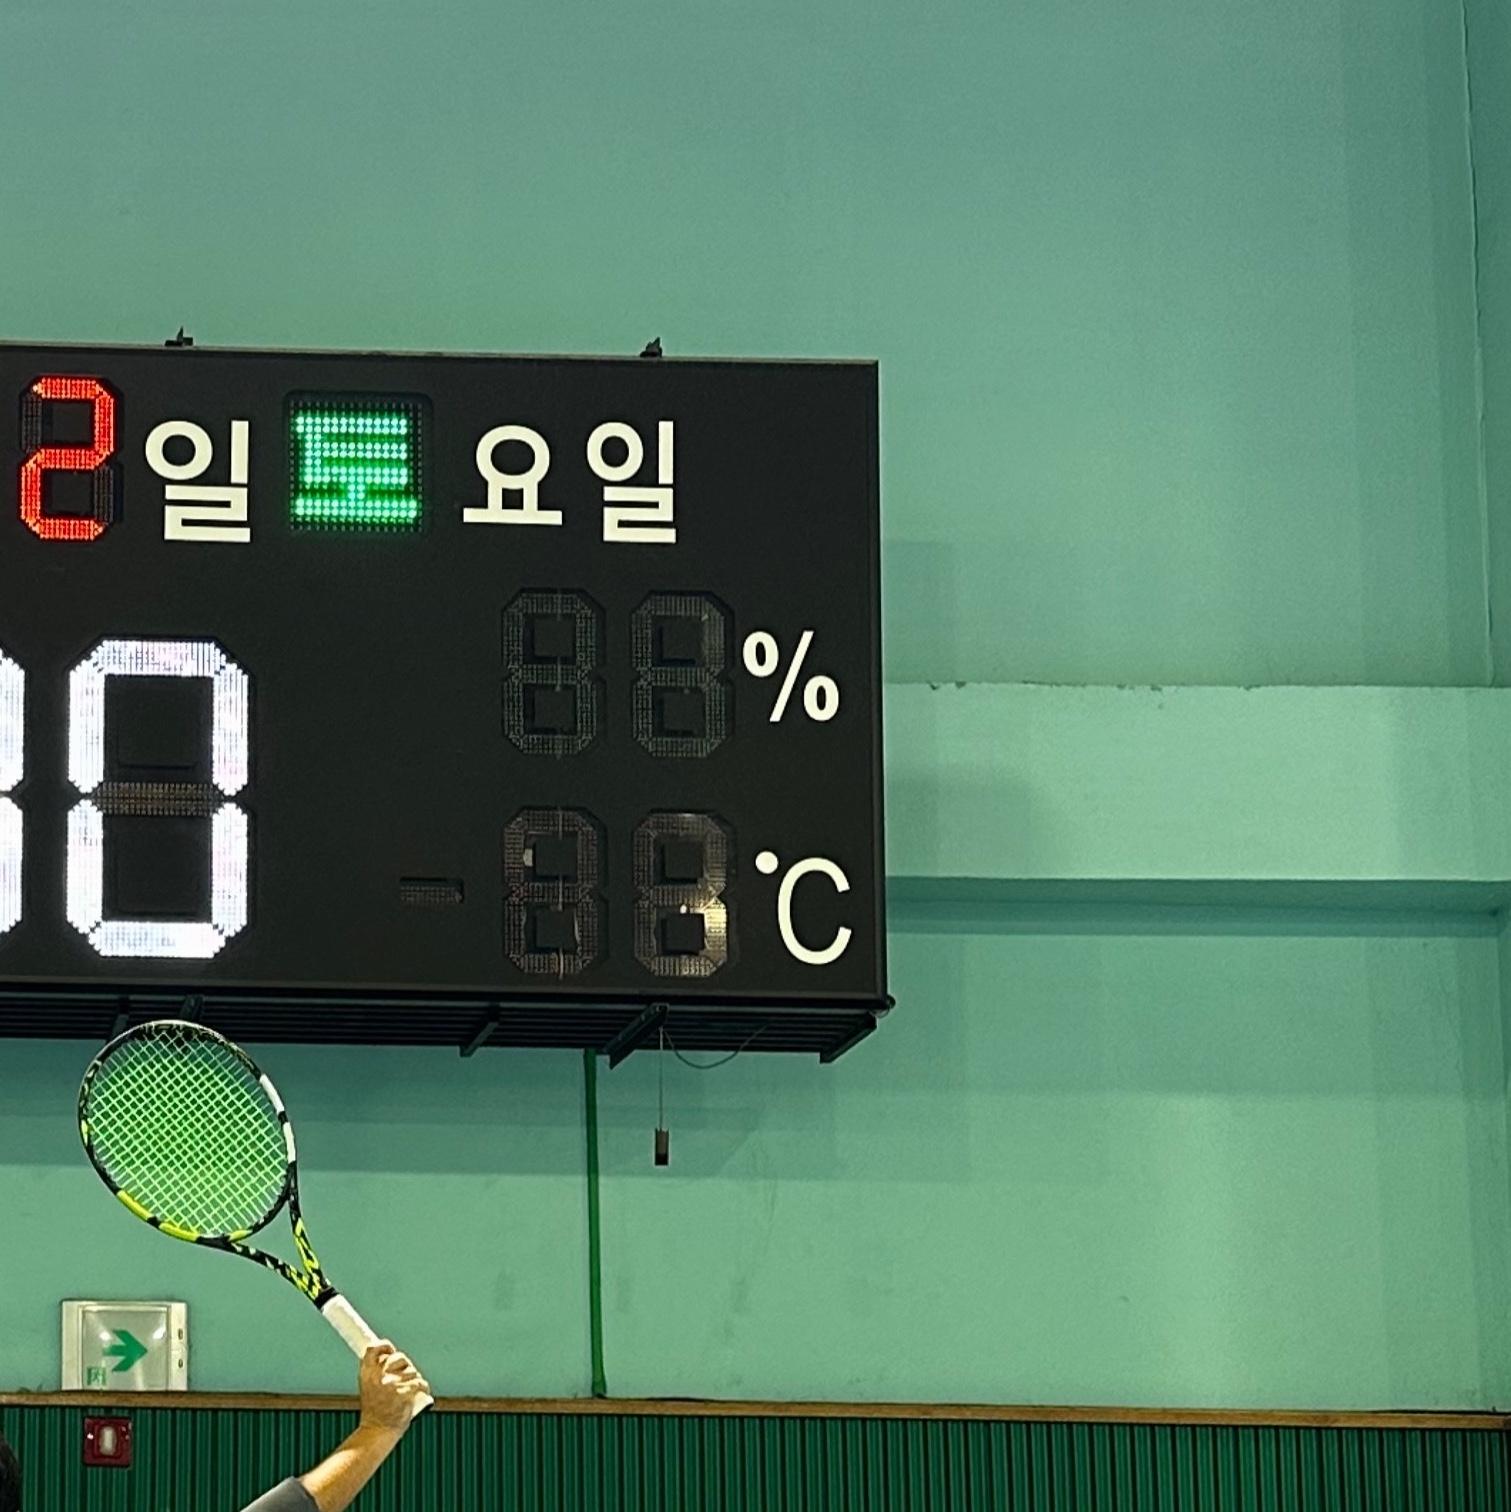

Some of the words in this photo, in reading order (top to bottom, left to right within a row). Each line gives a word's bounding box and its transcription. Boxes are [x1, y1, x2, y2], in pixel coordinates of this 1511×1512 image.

[145, 420, 251, 543] 일
[291, 410, 422, 532] 토
[742, 630, 839, 722] %
